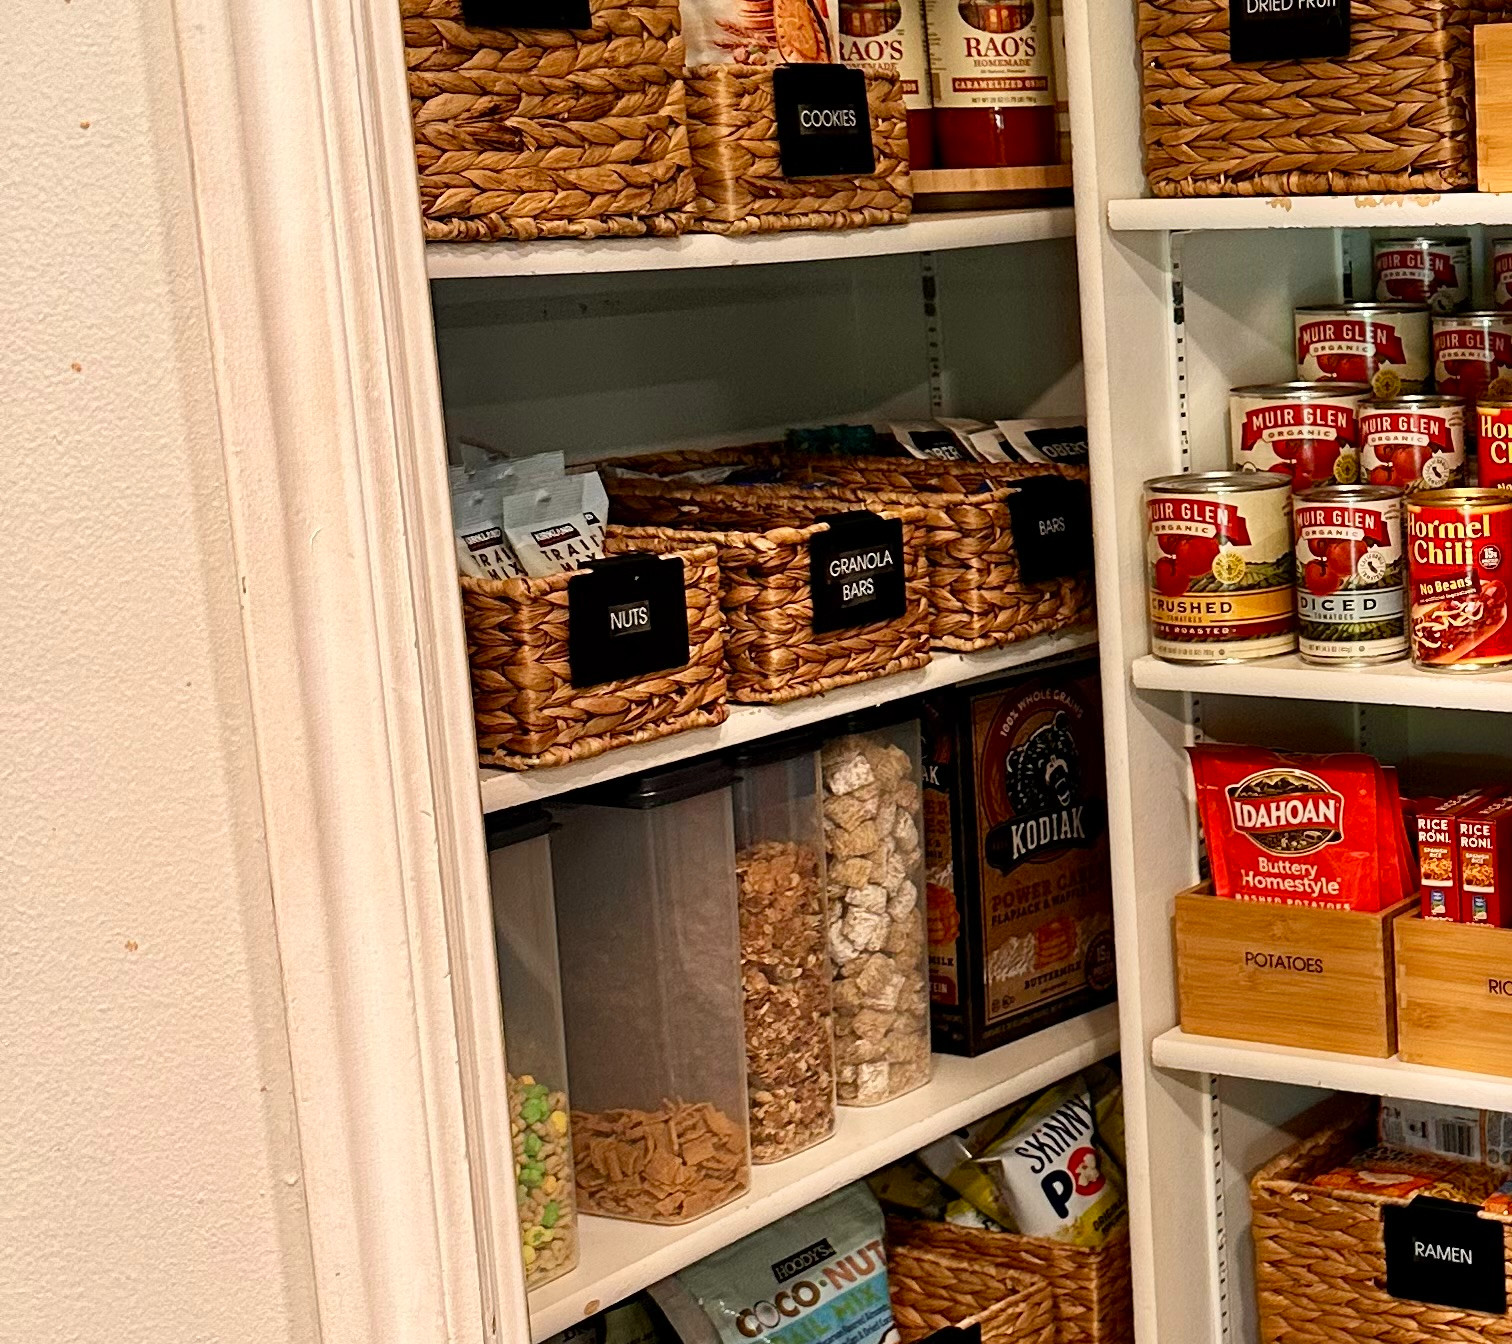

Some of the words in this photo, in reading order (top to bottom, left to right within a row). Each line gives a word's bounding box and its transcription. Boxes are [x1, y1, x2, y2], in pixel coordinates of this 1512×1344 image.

[963, 36, 1037, 59] RAO'S
[973, 58, 1032, 68] HOMEMADE
[955, 77, 1024, 91] CARAMELIZED
[800, 108, 857, 130] COOKIES
[1301, 325, 1335, 345] MUIR
[1343, 324, 1387, 344] GLEN
[1251, 409, 1295, 430] MUIR
[1303, 407, 1348, 429] GLEN
[1398, 416, 1440, 436] GLEN
[1267, 429, 1331, 440] ORGANIC
[1371, 434, 1424, 445] ORGANIC
[1039, 516, 1066, 537] BARS
[1180, 504, 1230, 527] GLEN
[1332, 510, 1376, 530] GLEN
[1408, 513, 1491, 539] Hormel
[1154, 524, 1209, 535] ORGANIC
[1304, 530, 1359, 538] ORGANIC
[829, 549, 894, 578] GRANOLA
[1414, 539, 1474, 566] Chili
[842, 577, 876, 601] BARS
[1420, 583, 1434, 596] No
[1435, 576, 1473, 592] Beans
[1151, 598, 1233, 614] CRUSHED
[1300, 598, 1377, 612] DICED
[610, 606, 649, 631] NUTS
[1000, 711, 1020, 739] 100%
[1017, 689, 1053, 714] WHOLE
[1053, 688, 1085, 720] GRAINS
[1233, 797, 1336, 829] IDAHOAN
[1417, 817, 1448, 831] RICE
[1012, 804, 1086, 860] KODIAK
[1460, 823, 1491, 837] RICE
[1257, 856, 1318, 880] Buttery
[1241, 869, 1340, 897] Homestyle
[1245, 951, 1324, 975] POTATOES
[776, 1241, 831, 1280] HOODY'S
[1413, 1240, 1474, 1266] RAMEN
